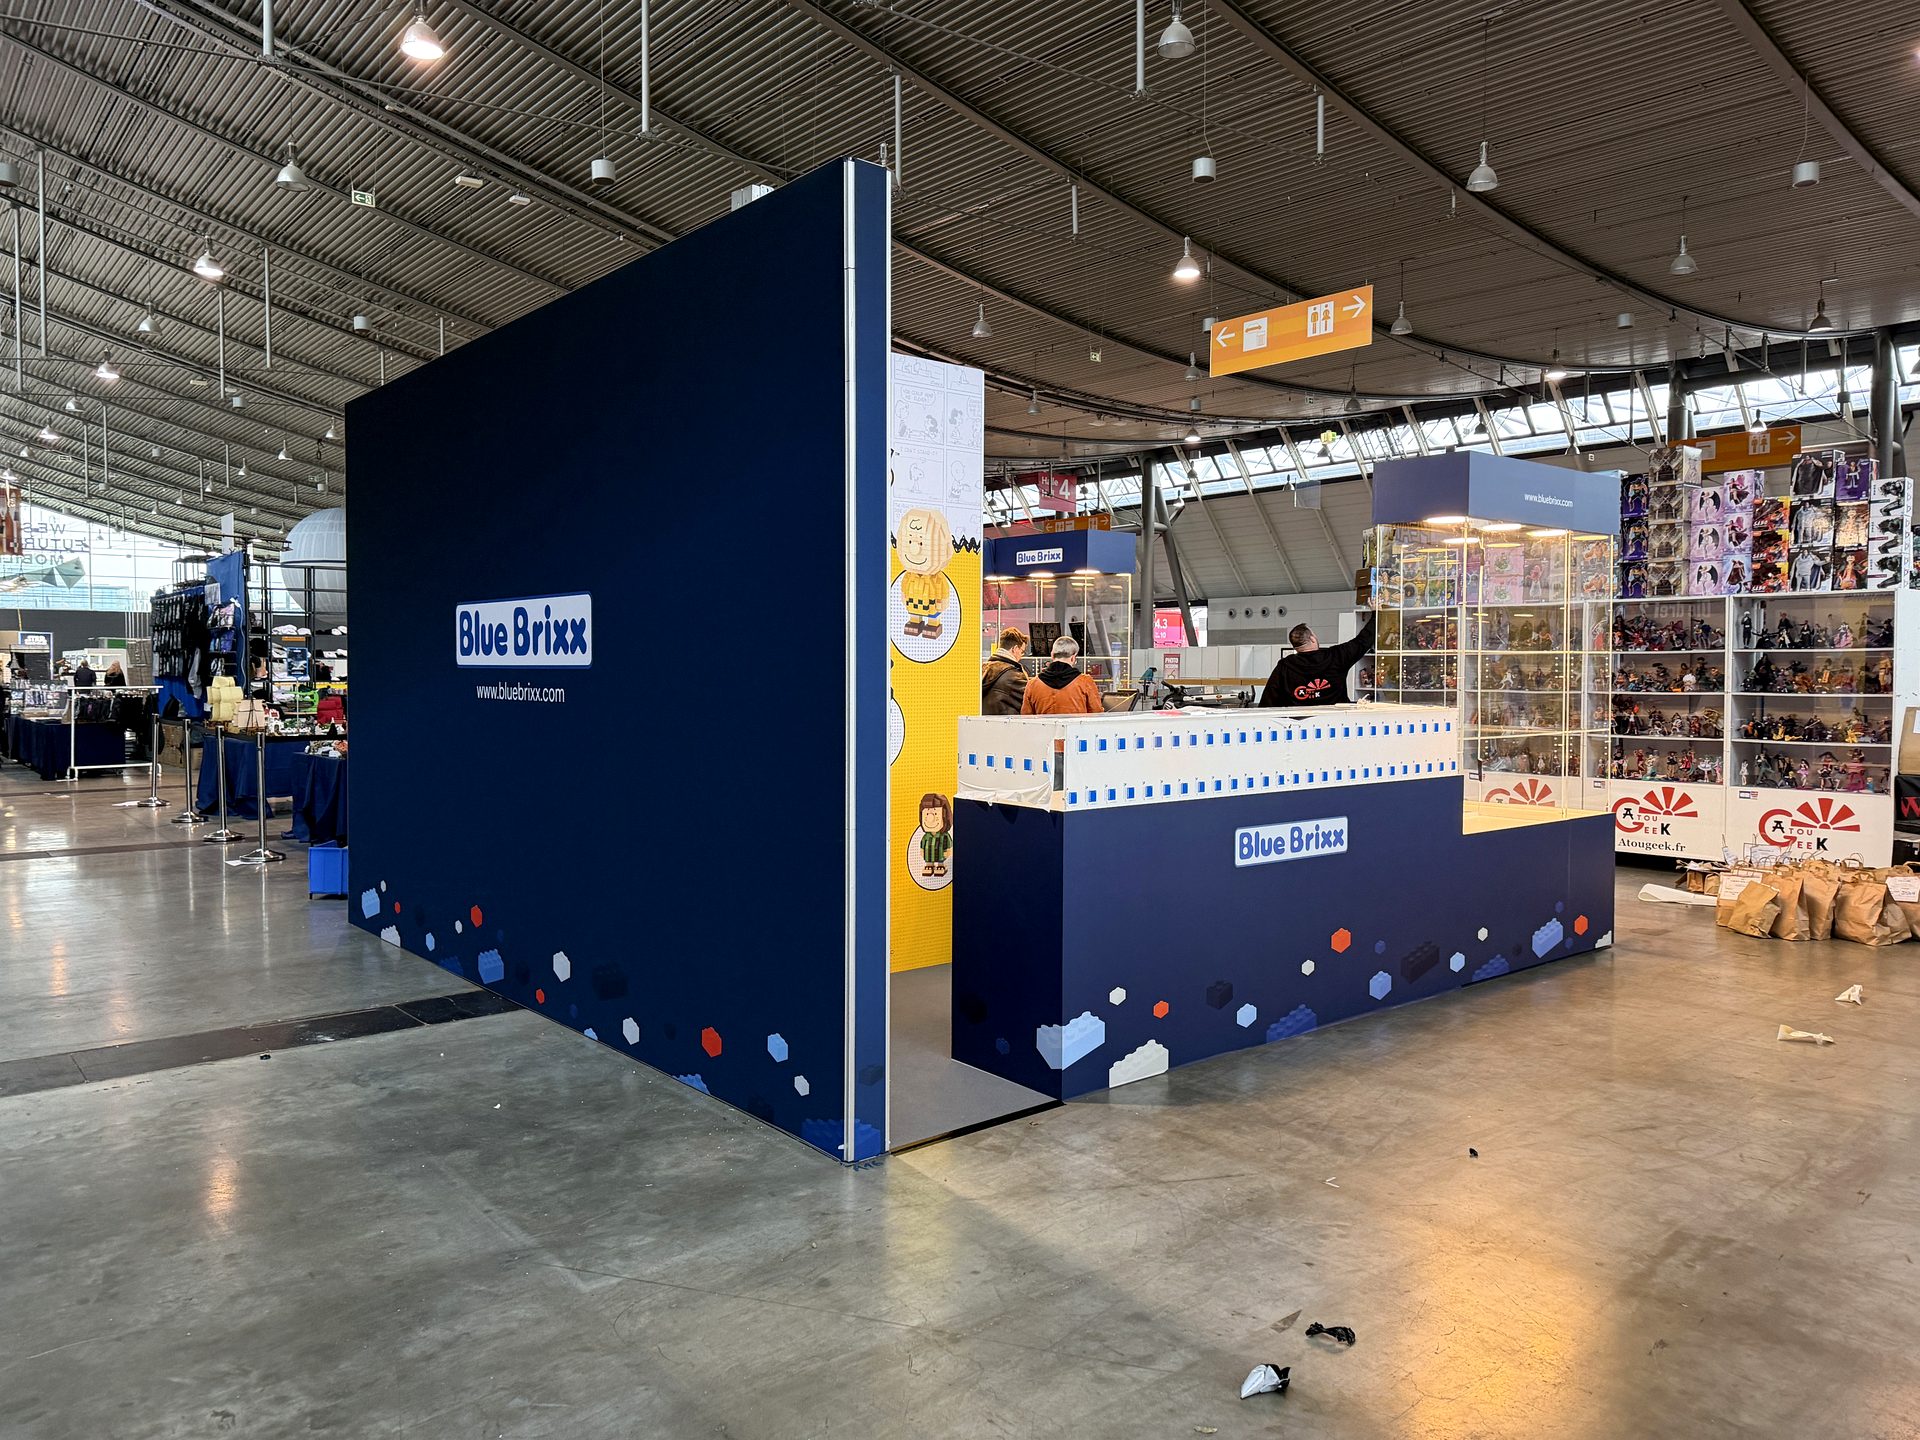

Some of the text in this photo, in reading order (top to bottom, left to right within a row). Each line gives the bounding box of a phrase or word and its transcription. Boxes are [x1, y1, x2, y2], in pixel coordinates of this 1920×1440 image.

[1041, 476, 1059, 487] Hale
[1059, 478, 1071, 500] 4
[1524, 493, 1574, 508] www.bluebrixx.com
[1017, 550, 1061, 563] Blue Brixx
[459, 604, 587, 656] Blue Brixx
[1154, 618, 1168, 629] 4.3
[476, 682, 565, 703] www.bluebrixx.com
[1239, 824, 1344, 860] Blue Brixx
[1618, 838, 1686, 852] Atougeek.fr
